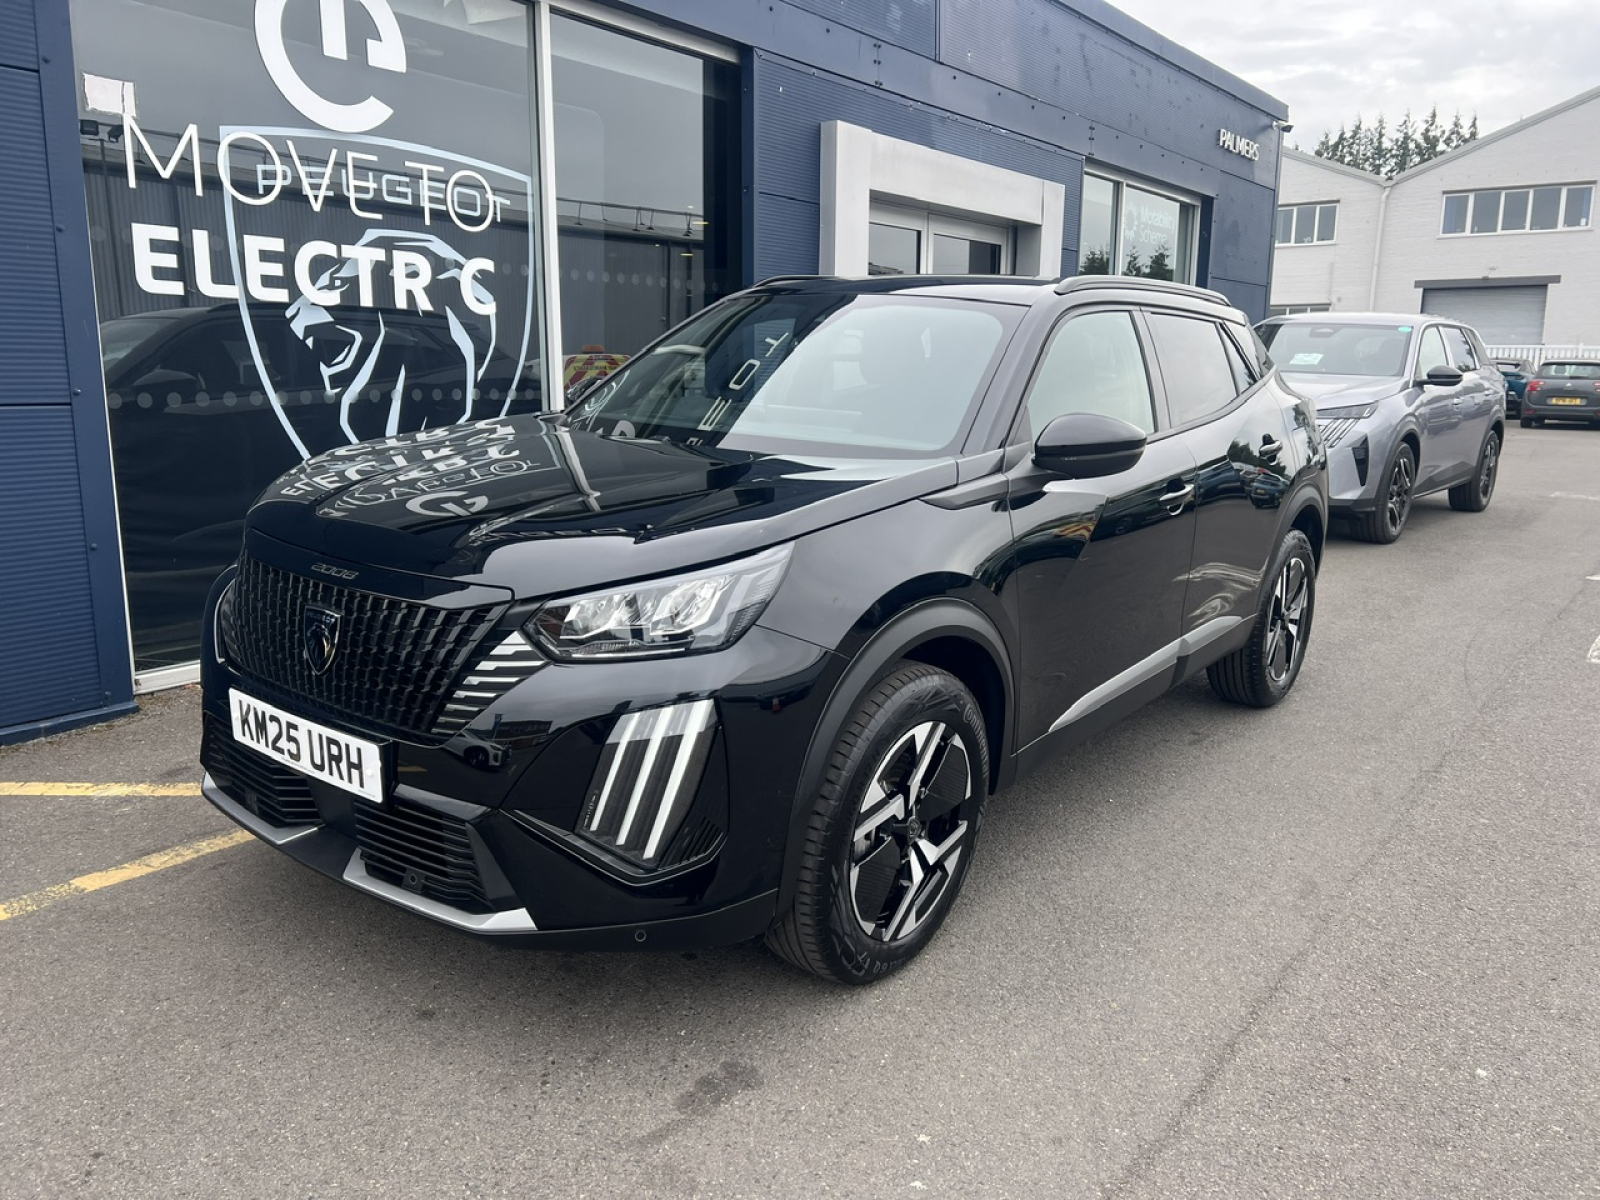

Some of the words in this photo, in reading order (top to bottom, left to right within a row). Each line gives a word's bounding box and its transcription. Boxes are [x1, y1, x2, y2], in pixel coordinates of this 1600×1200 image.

[122, 113, 383, 220] MOVE
[405, 161, 495, 232] TO
[1219, 128, 1260, 161] PALMERS
[256, 164, 510, 223] PEUGEOT
[131, 222, 496, 316] ELECTRC
[311, 562, 359, 580] 2008
[238, 699, 301, 762] KM25
[306, 729, 365, 789] URH
